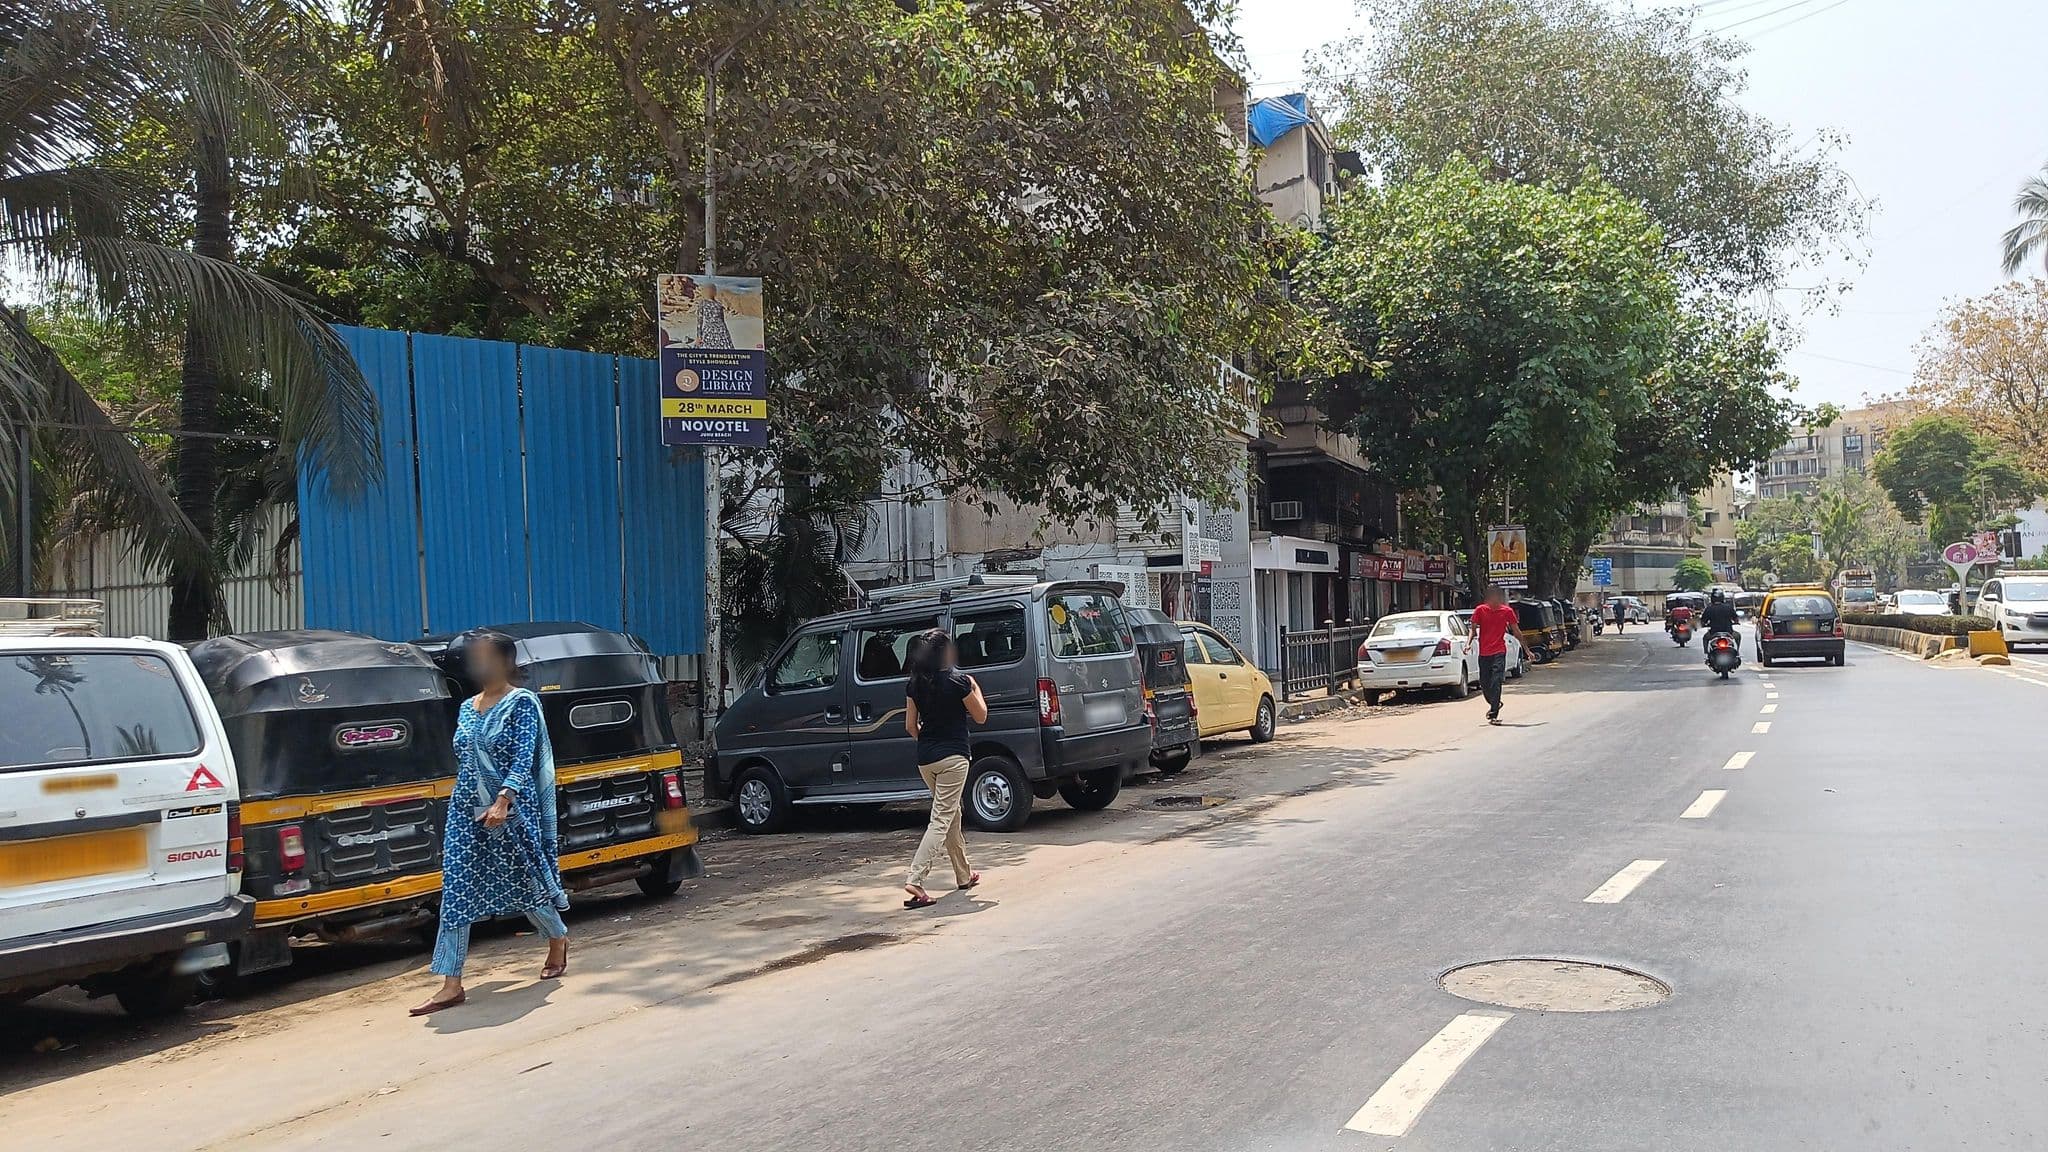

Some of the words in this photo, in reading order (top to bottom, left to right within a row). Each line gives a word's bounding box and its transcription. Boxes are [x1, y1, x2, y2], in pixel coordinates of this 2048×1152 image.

[702, 369, 753, 381] DESIGN
[702, 380, 753, 391] LIBRARY
[678, 402, 703, 413] 28th
[706, 404, 752, 414] MARCH
[681, 420, 750, 432] NOVOTEL
[1381, 560, 1402, 569] ATM
[1496, 561, 1527, 570] APRIL
[192, 806, 221, 815] Cargo
[166, 848, 222, 863] SIGNAL
